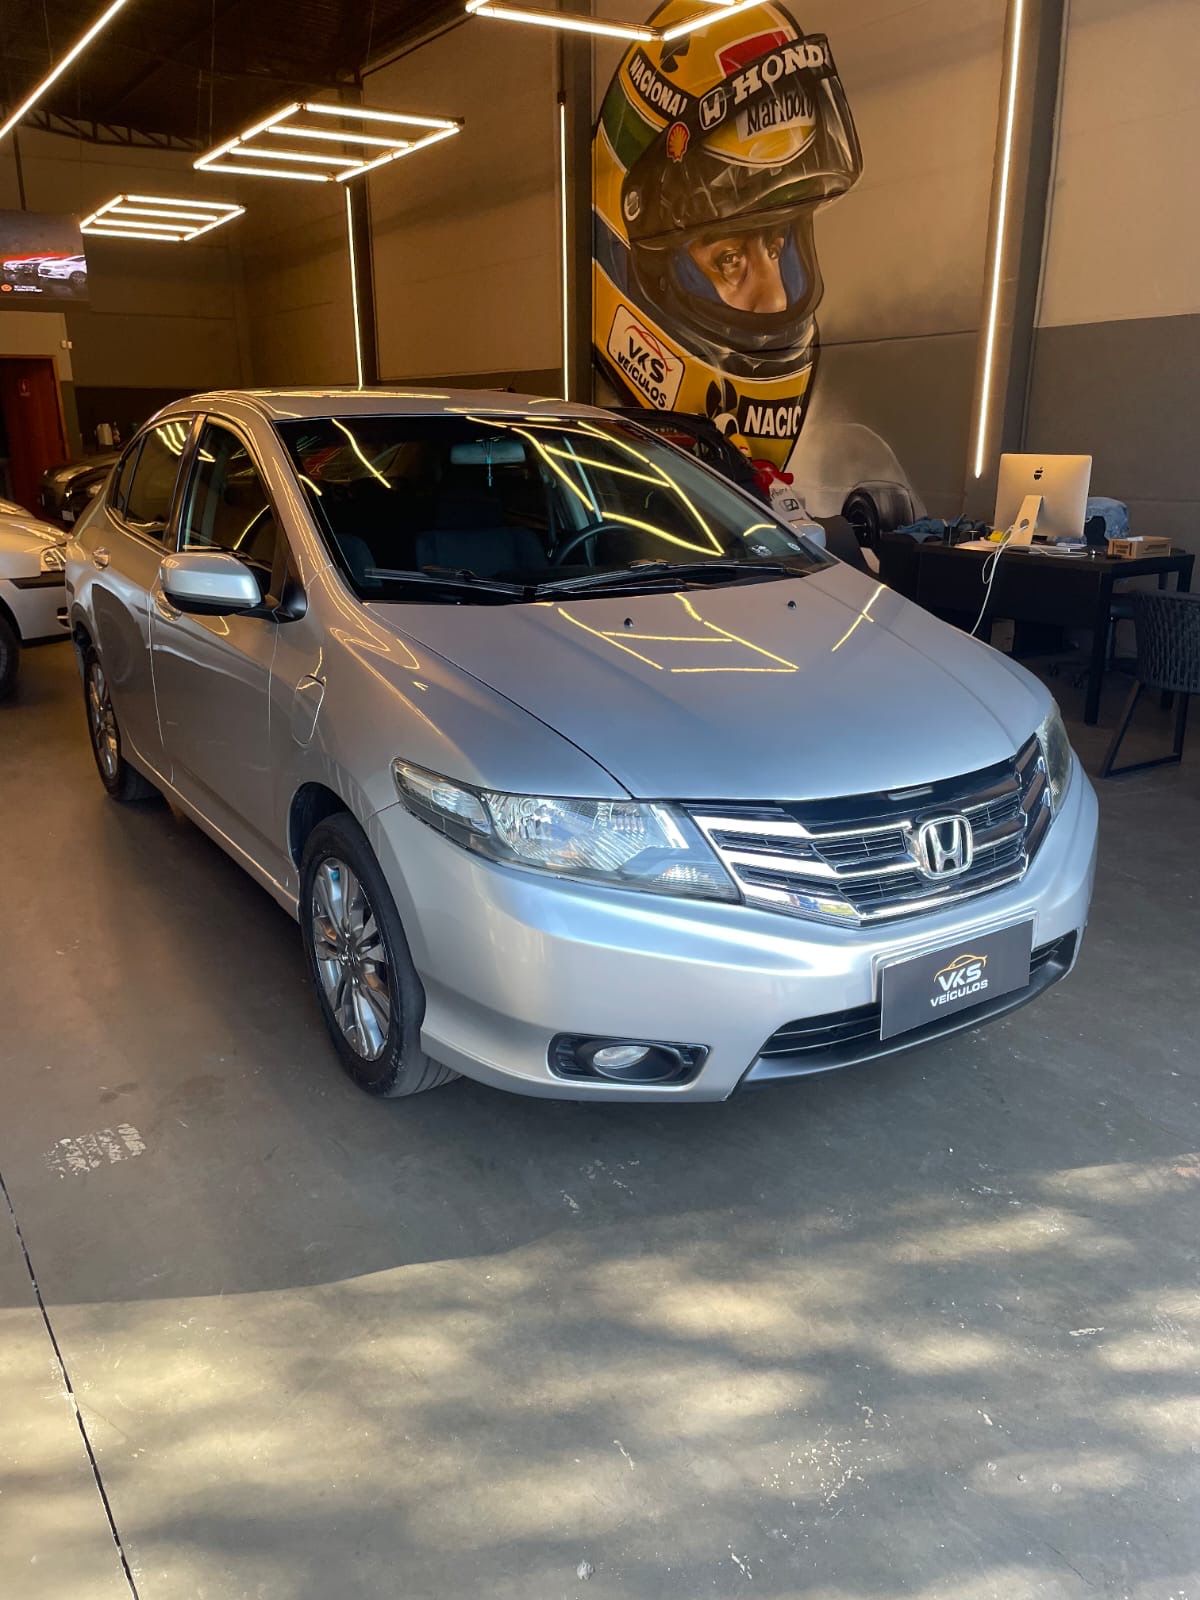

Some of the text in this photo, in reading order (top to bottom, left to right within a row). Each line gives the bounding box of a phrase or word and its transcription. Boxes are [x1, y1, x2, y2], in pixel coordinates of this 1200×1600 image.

[733, 45, 825, 104] HOND
[629, 336, 665, 384] VKS
[930, 979, 989, 1007] VEÍCULOS
[938, 962, 982, 991] VKS
